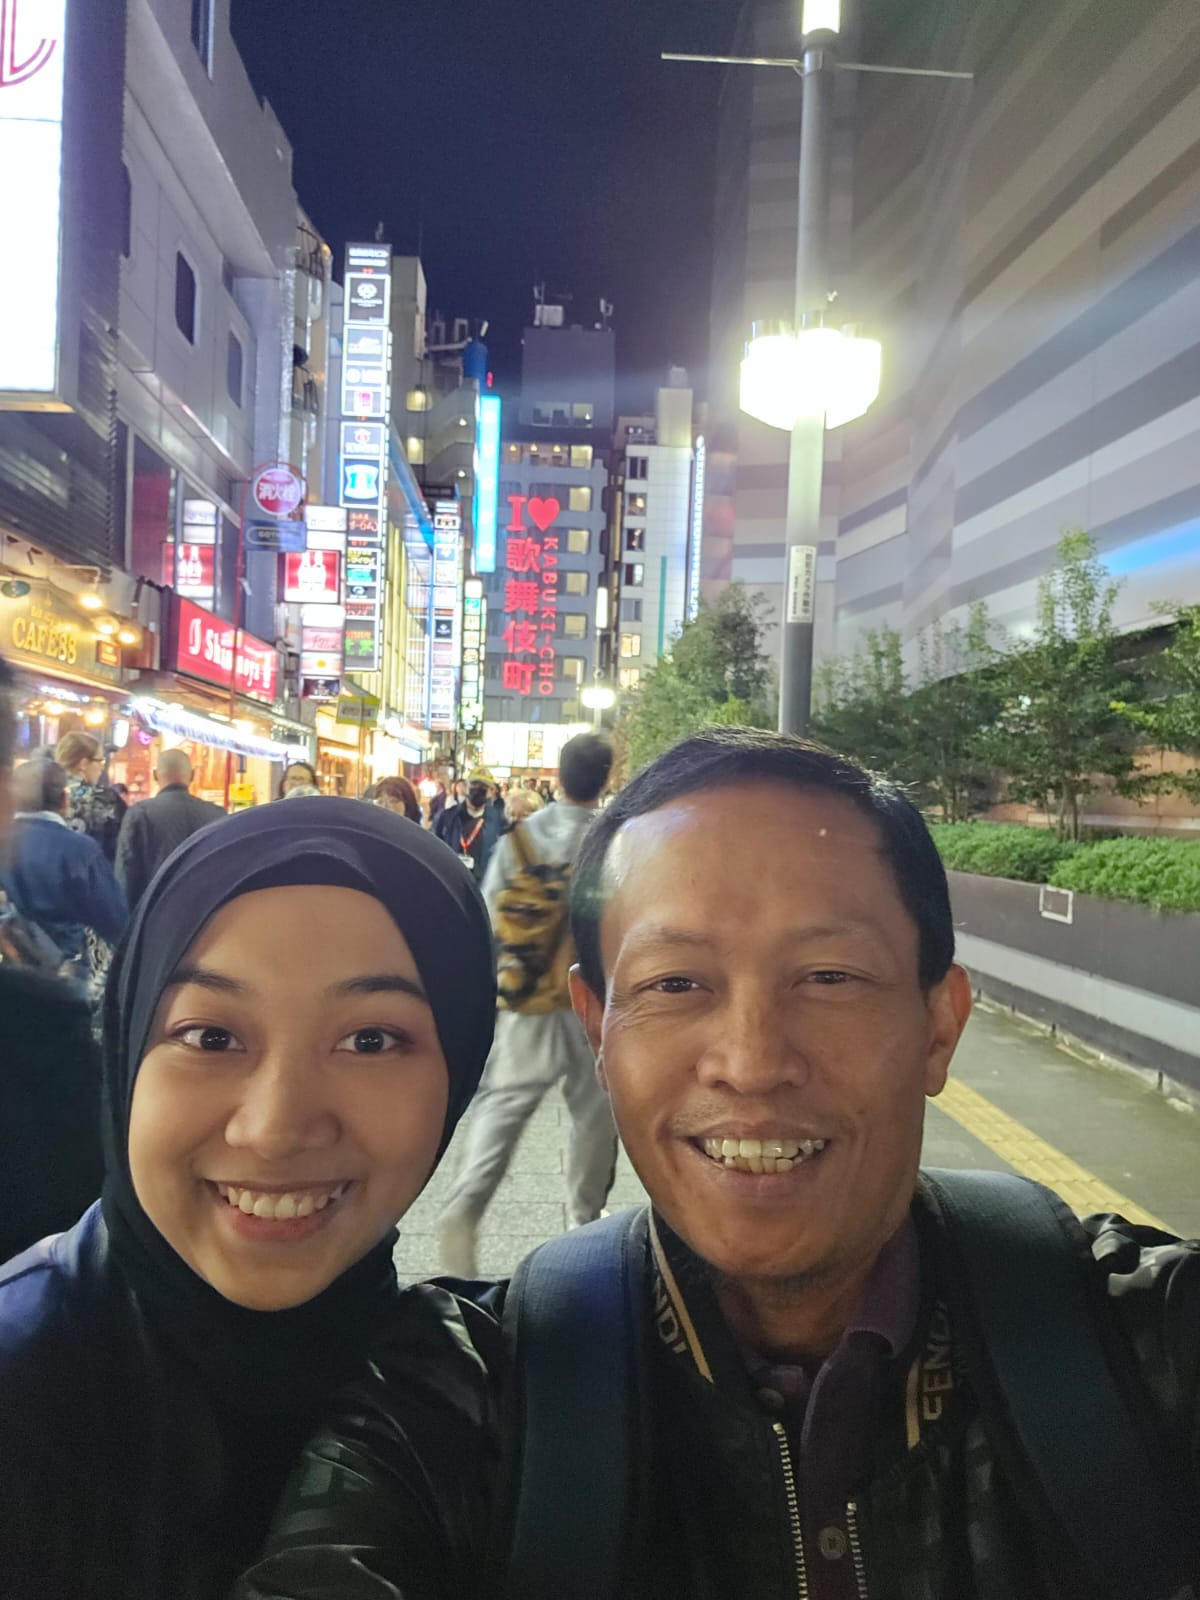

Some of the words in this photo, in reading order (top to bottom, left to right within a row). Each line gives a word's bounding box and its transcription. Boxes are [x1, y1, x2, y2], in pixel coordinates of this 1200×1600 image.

[258, 483, 299, 502] 消火栓
[506, 494, 528, 532] I
[502, 537, 541, 696] 歌舞伎町
[538, 536, 560, 695] KABUKI-CHO
